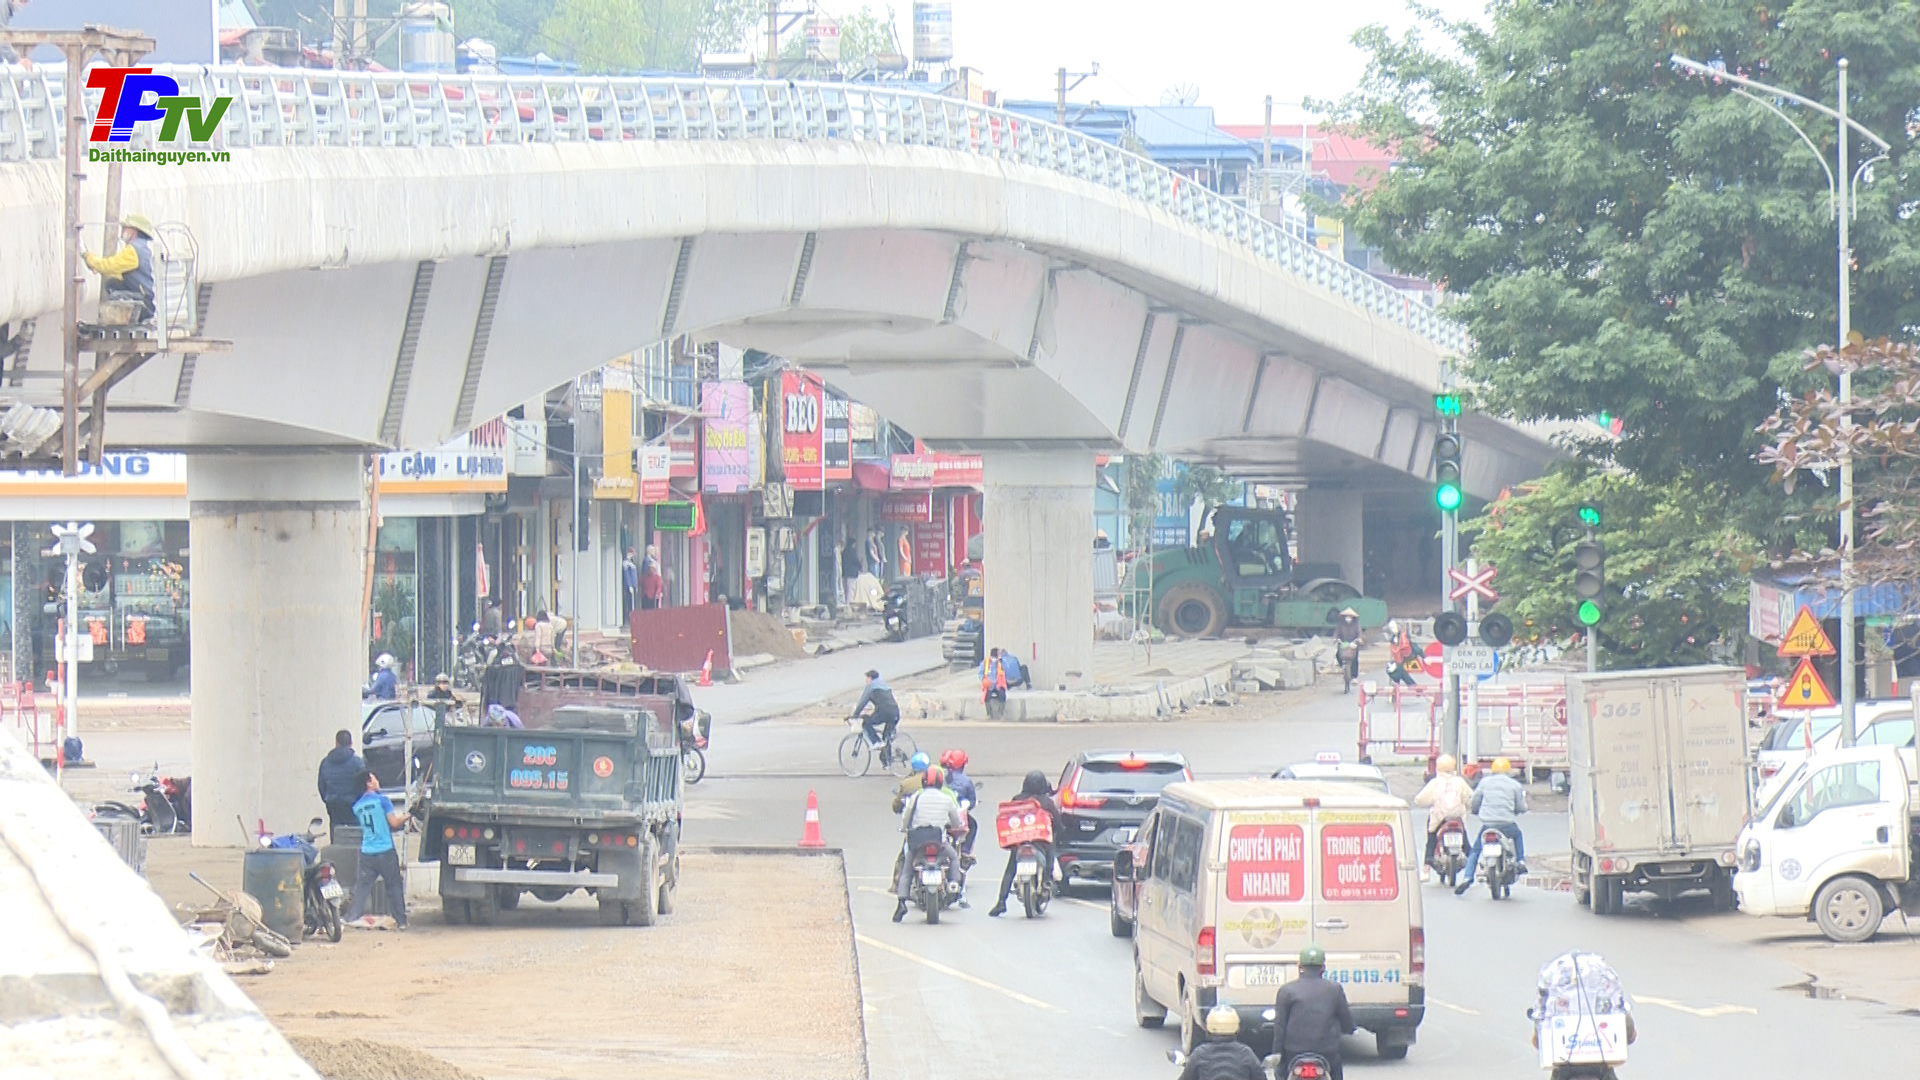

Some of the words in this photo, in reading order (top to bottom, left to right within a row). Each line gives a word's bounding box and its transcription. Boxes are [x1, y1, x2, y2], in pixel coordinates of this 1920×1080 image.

[786, 382, 818, 433] BÉO
[1436, 396, 1461, 416] 44
[917, 502, 928, 513] ĐÁ
[1602, 702, 1641, 718] 365
[363, 814, 375, 834] 4
[1230, 829, 1272, 862] CHUYỂN
[1274, 833, 1301, 861] PHÁT
[1326, 836, 1360, 856] TRONG
[1363, 831, 1393, 855] NƯỚC
[1338, 857, 1366, 885] QUỐC
[1369, 857, 1382, 883] TẾ
[1242, 872, 1290, 897] NHANH
